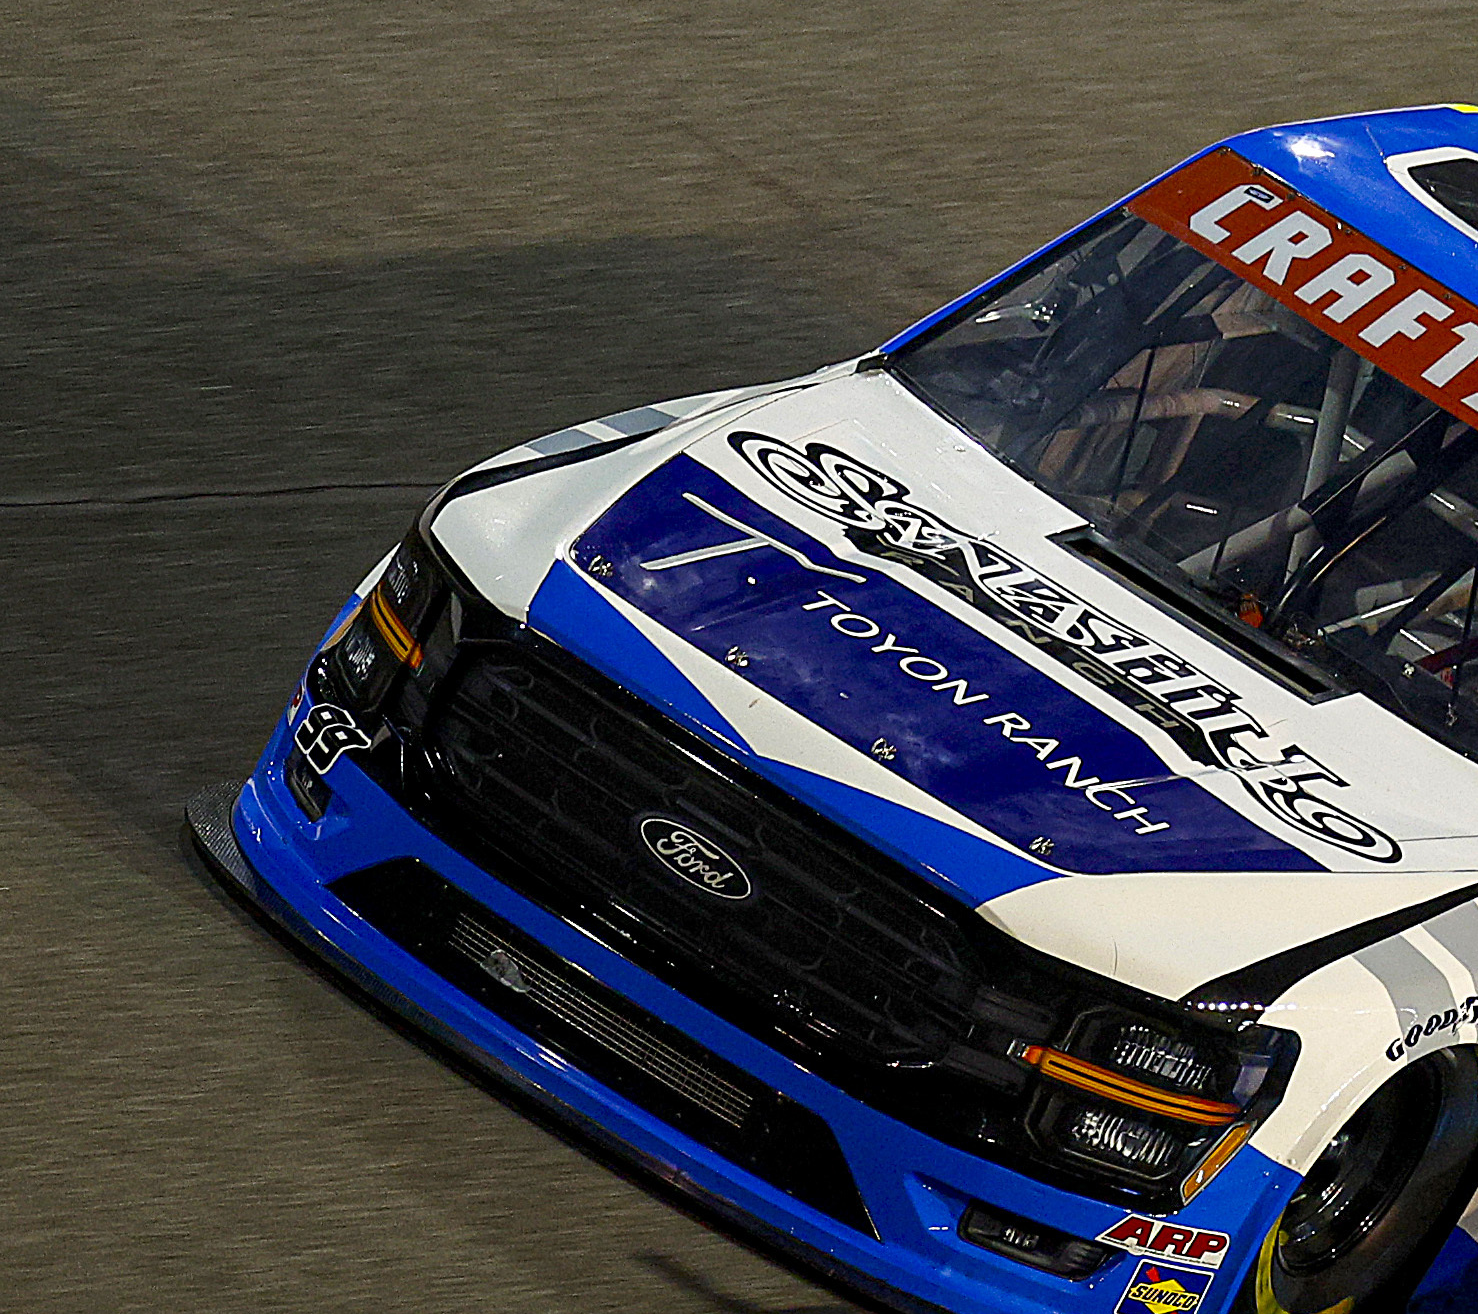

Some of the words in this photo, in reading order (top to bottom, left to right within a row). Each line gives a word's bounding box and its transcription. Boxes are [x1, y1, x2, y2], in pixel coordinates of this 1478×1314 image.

[801, 590, 988, 707] TOYON
[983, 713, 1170, 836] RANCH
[670, 821, 742, 893] Ford
[1108, 1219, 1227, 1258] ARP
[1134, 1284, 1198, 1308] SUNOCO
